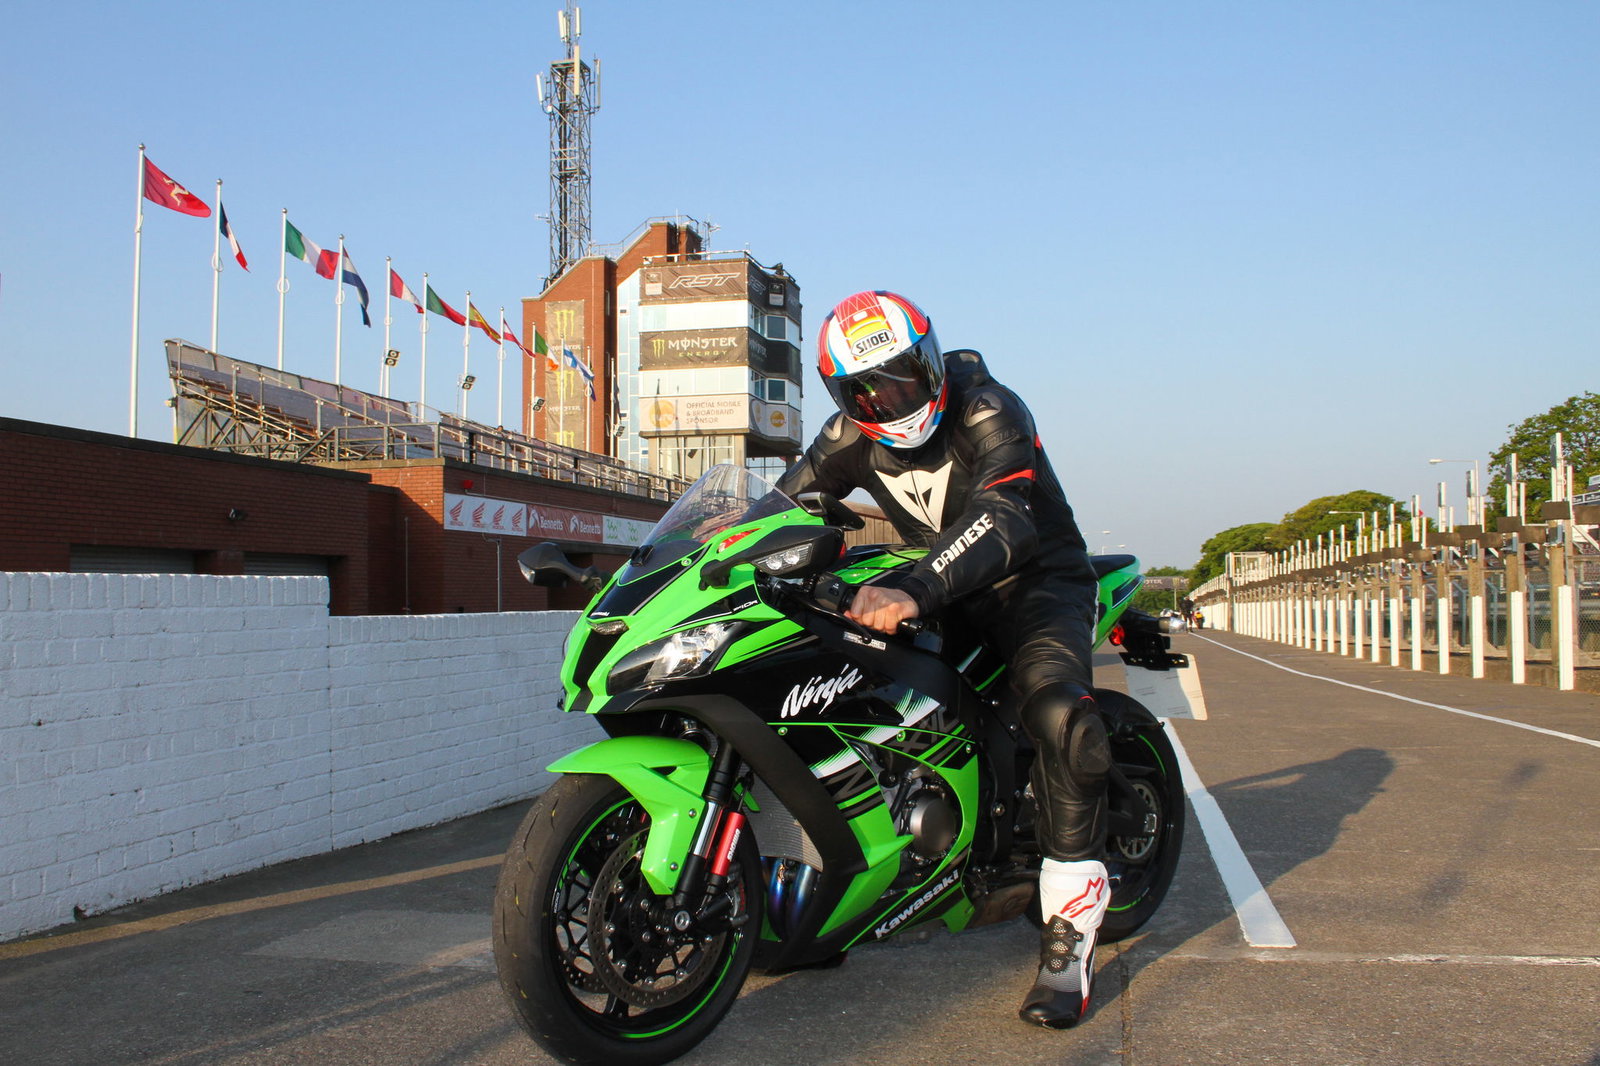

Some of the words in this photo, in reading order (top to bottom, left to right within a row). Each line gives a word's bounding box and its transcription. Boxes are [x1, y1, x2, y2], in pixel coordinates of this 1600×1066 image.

[669, 272, 741, 288] RST
[668, 336, 738, 350] MONSTER
[856, 332, 890, 354] SHOEI
[692, 409, 734, 417] BROADBAND
[540, 516, 564, 531] Bennetts
[579, 521, 602, 535] Bennetts
[931, 513, 994, 573] DAINESE
[780, 663, 863, 718] Ninja
[875, 869, 960, 939] Kawasaki
